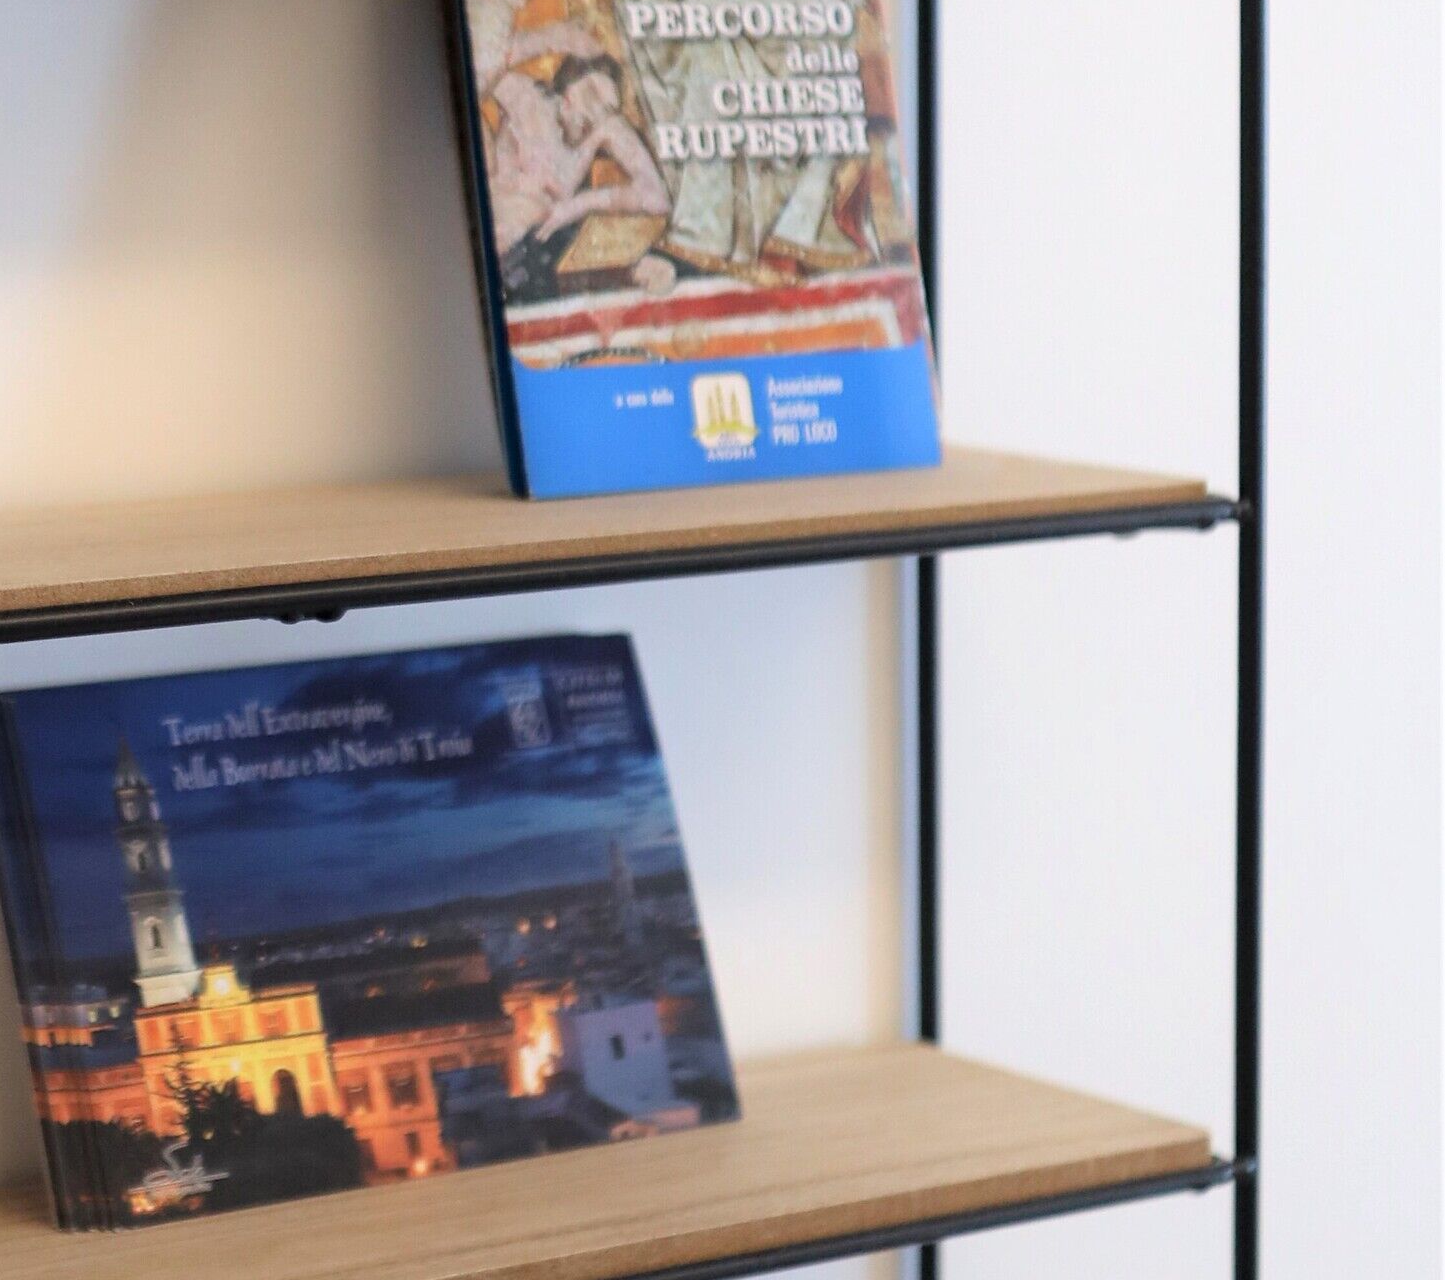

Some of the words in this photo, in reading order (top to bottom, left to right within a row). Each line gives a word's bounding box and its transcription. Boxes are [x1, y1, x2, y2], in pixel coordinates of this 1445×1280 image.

[785, 42, 859, 73] delle
[713, 76, 864, 117] CHIESE
[656, 115, 870, 160] RUPESTRI
[772, 423, 800, 445] PRO
[161, 714, 224, 746] Terra
